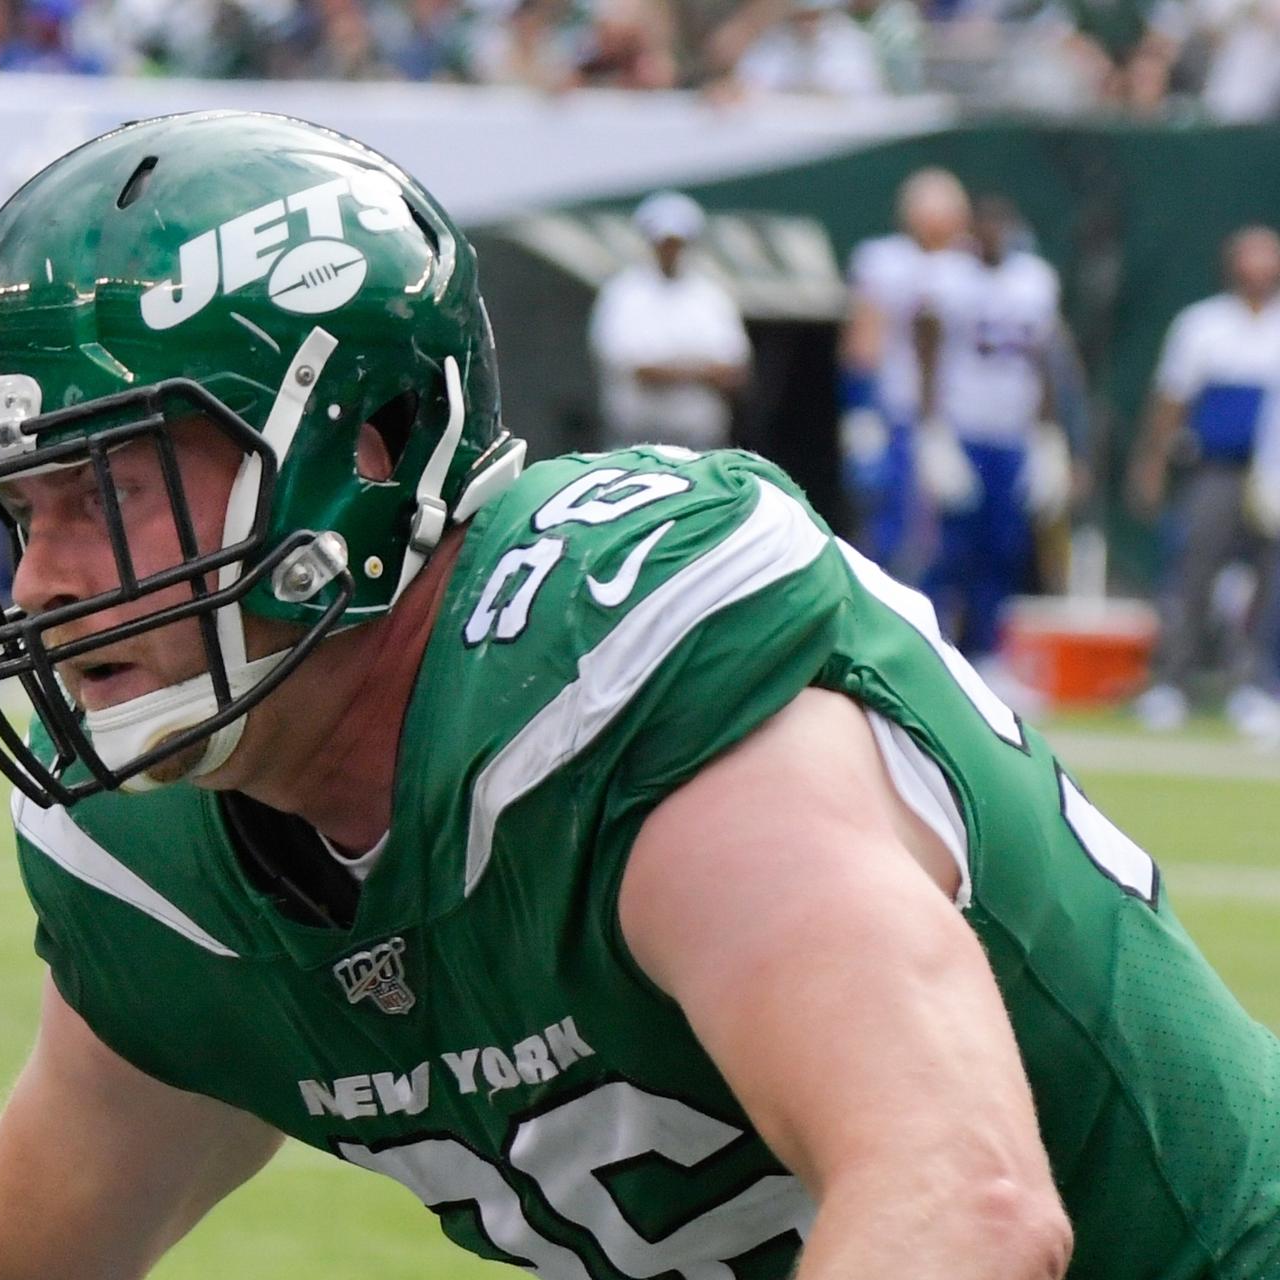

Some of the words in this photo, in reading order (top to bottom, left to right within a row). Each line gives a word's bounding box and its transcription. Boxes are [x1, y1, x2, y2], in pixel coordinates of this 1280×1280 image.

[139, 168, 413, 331] JETS
[461, 466, 697, 650] 96
[298, 1060, 431, 1120] NEW
[440, 1016, 596, 1097] YORK
